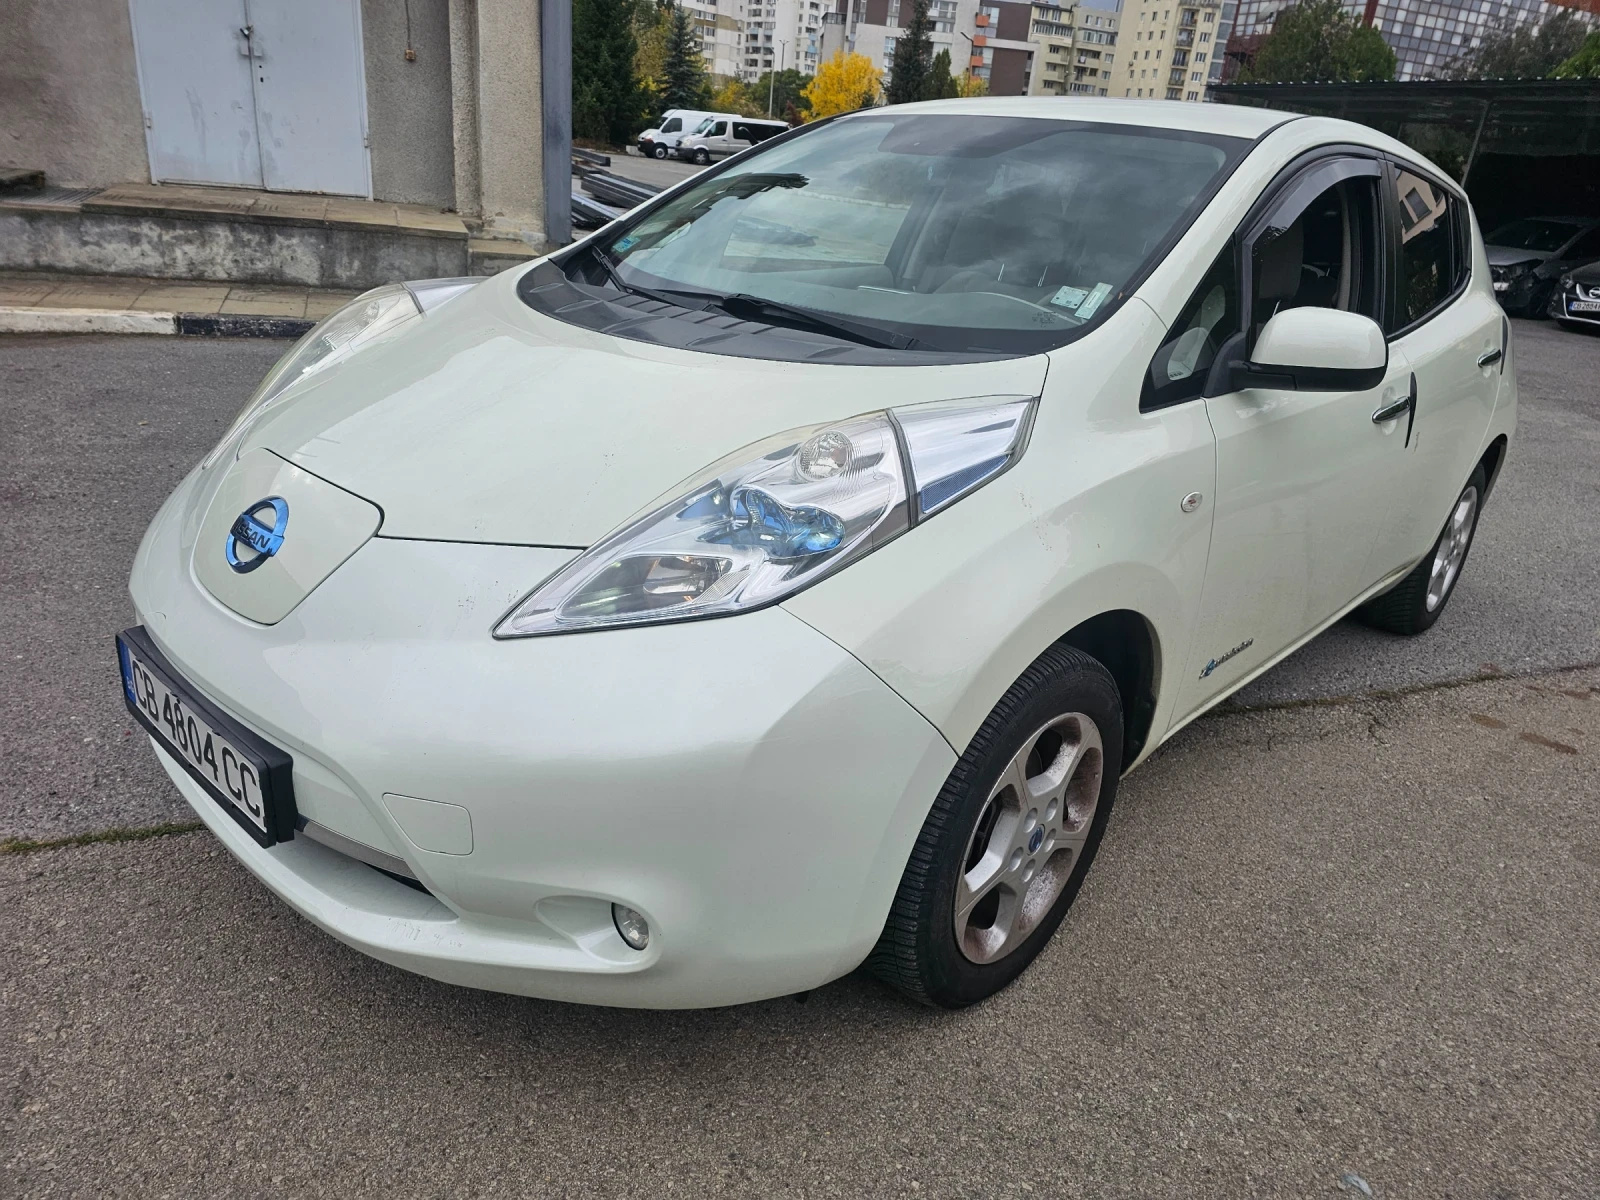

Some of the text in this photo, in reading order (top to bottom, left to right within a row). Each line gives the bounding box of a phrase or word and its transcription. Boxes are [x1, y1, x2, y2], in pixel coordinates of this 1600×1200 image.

[133, 659, 261, 818] CB 4804 CC
